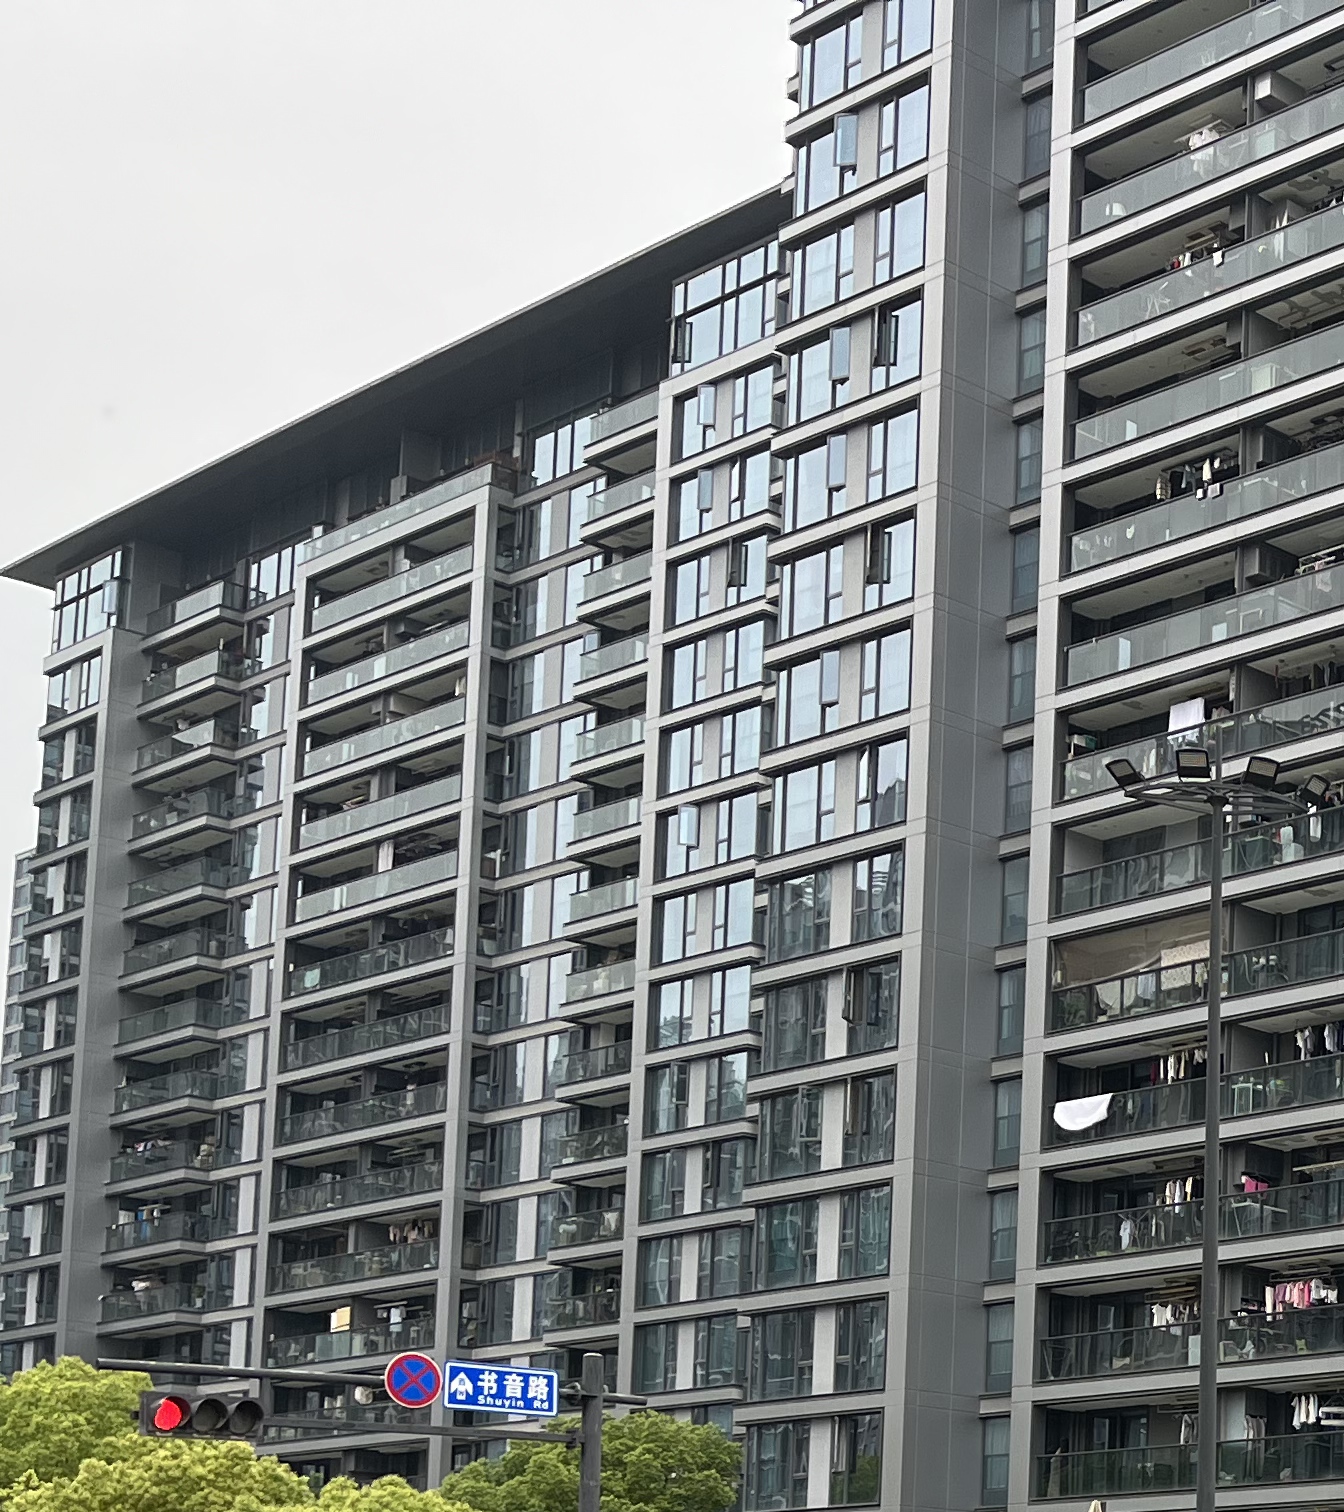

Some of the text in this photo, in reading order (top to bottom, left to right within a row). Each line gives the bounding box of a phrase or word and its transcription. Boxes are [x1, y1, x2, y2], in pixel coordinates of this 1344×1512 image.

[477, 1370, 549, 1400] 书音路
[477, 1395, 549, 1409] Shuyin Rd
